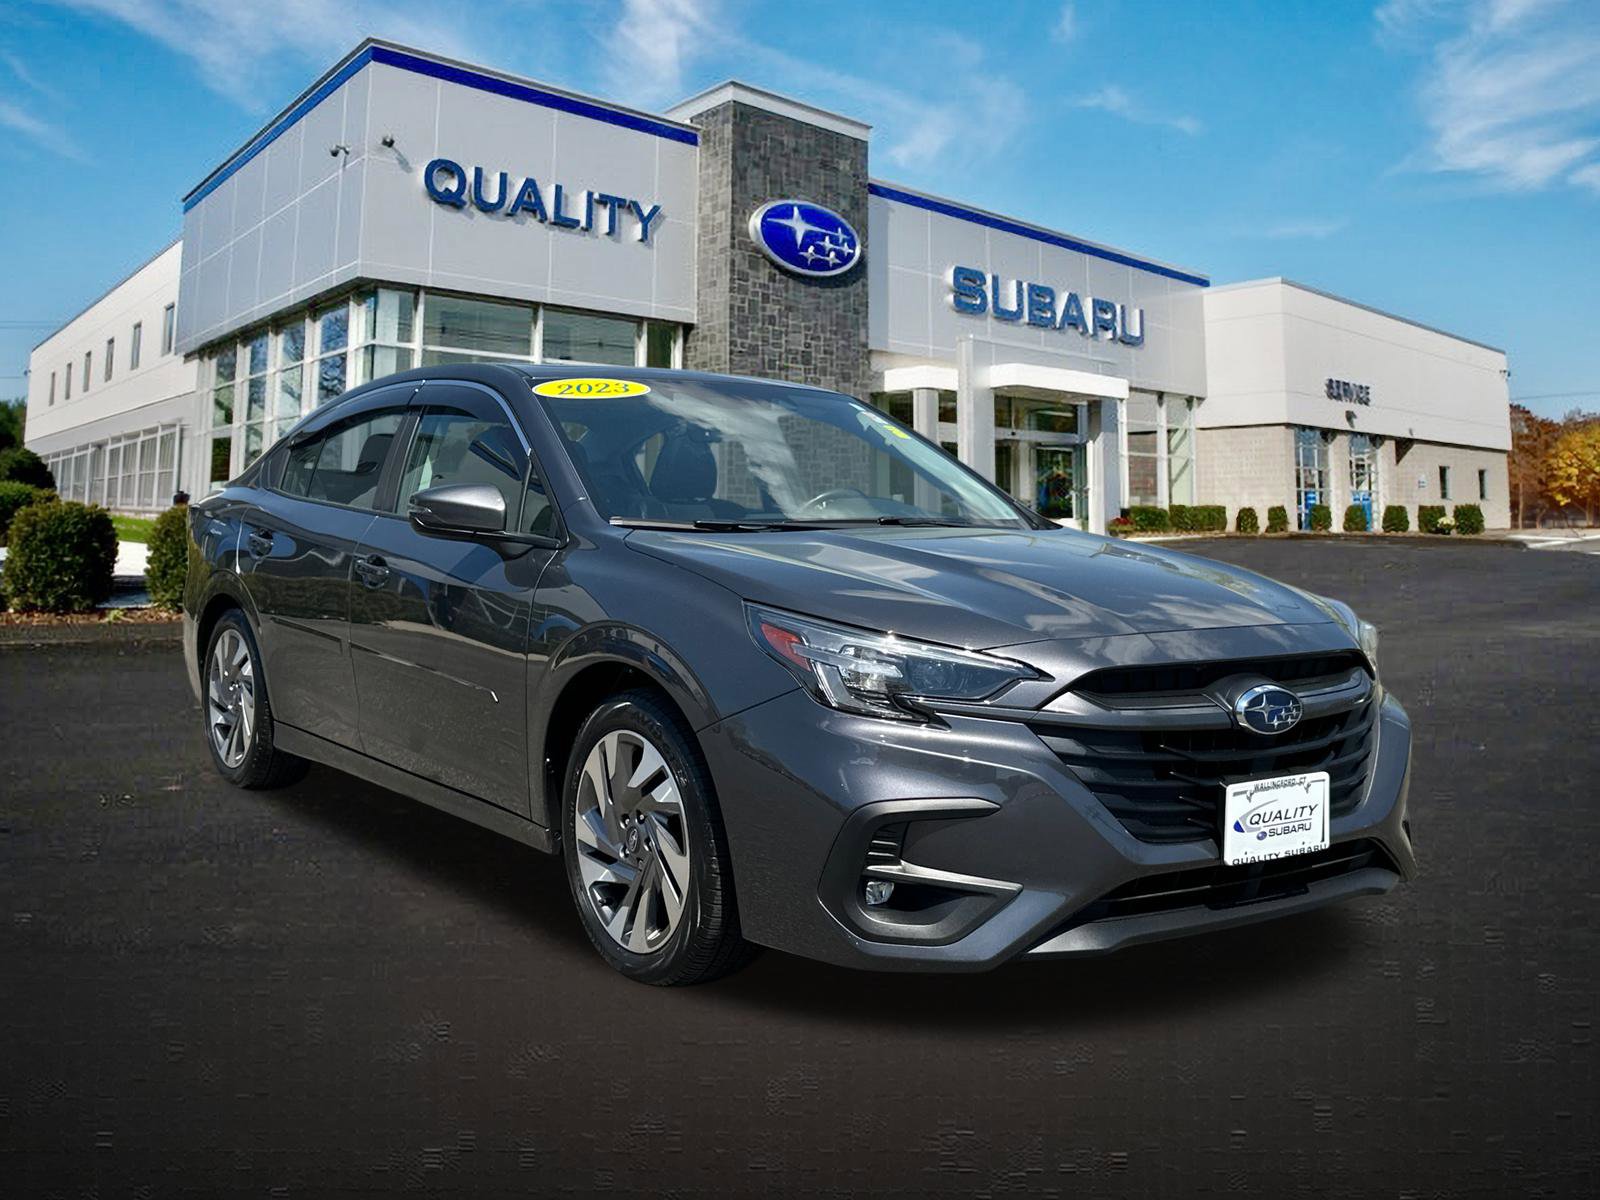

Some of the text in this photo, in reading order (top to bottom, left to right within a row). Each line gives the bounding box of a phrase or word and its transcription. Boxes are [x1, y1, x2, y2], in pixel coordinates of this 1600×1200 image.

[424, 158, 661, 242] QUALITY
[950, 266, 1144, 346] SUBARU
[557, 382, 630, 396] 2023
[1325, 378, 1371, 406] SERVICE
[1249, 804, 1319, 826] QUALITY
[1268, 822, 1312, 837] SUBARU
[1232, 843, 1327, 866] QUALITY SUBARU
